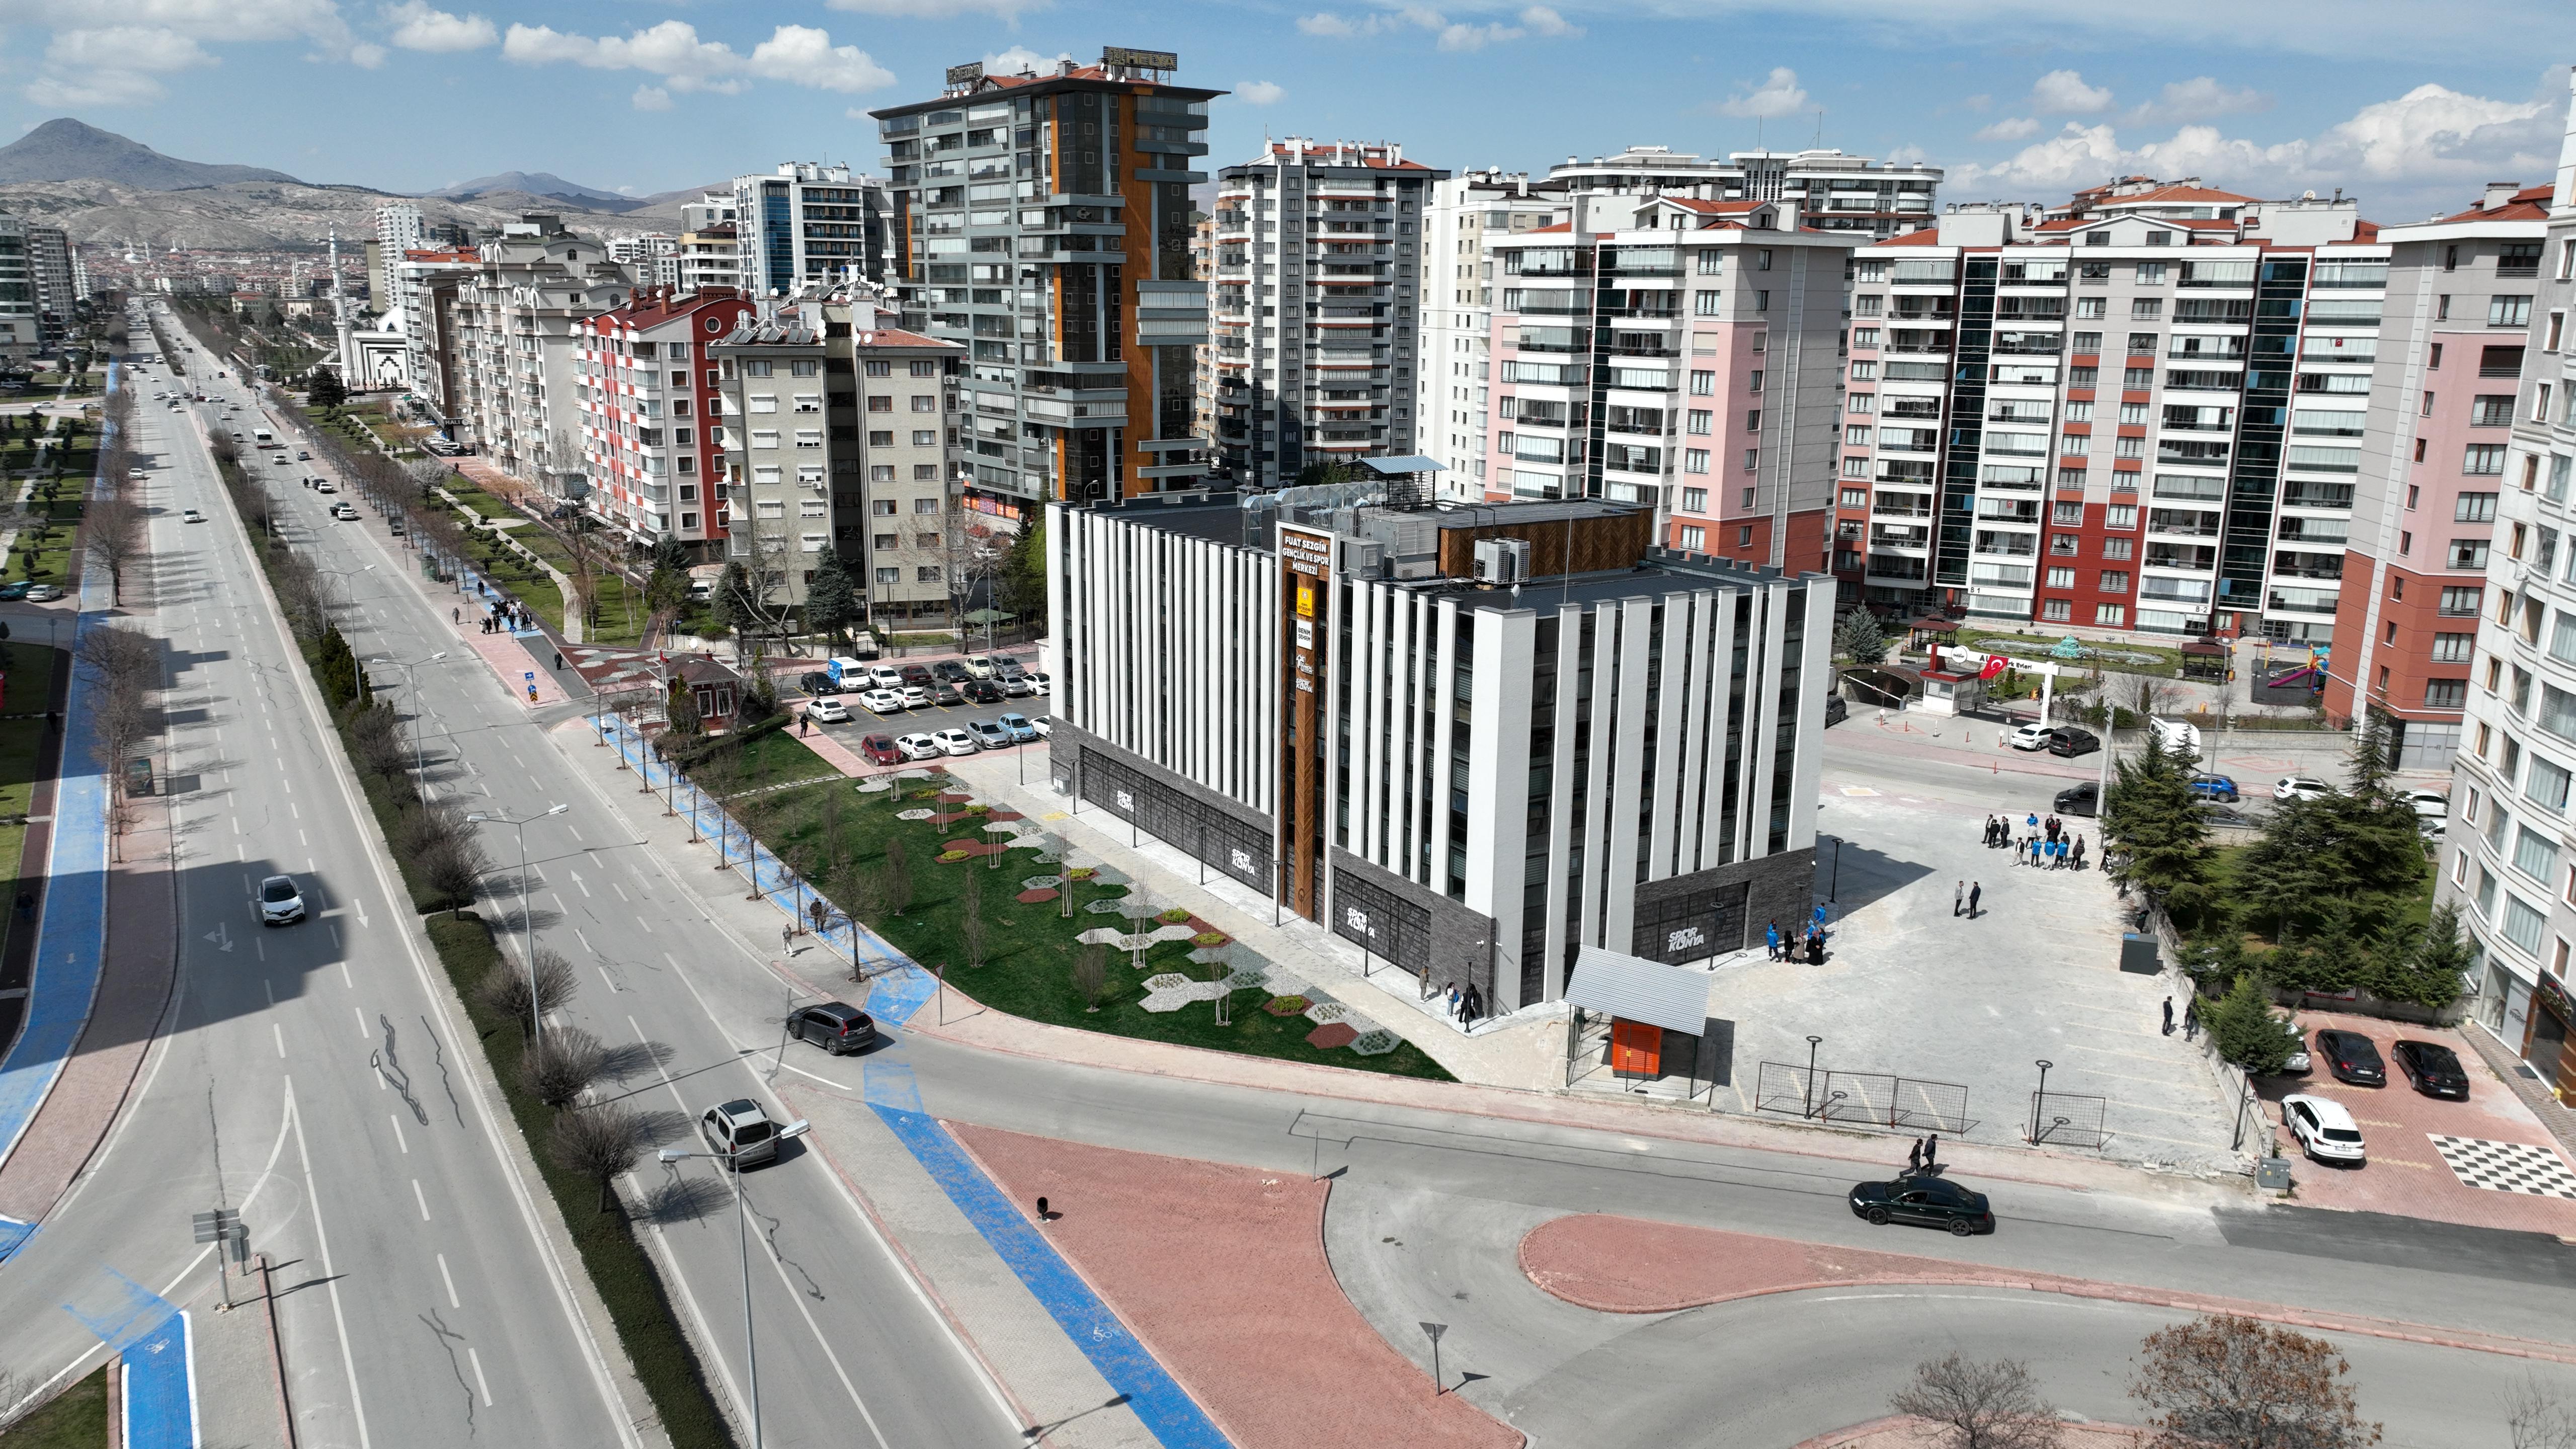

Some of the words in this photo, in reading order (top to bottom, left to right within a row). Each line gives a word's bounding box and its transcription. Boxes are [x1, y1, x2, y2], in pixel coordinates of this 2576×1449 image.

[1126, 51, 1176, 68] HELYA
[954, 65, 982, 81] HELYA
[1285, 536, 1301, 547] FUAT
[1302, 540, 1326, 553] SEZGİN
[1282, 547, 1305, 560] GENÇLİK
[1306, 552, 1313, 562] VE
[1314, 554, 1329, 566] SPOR
[1293, 561, 1317, 576] MERKEZİ
[1296, 678, 1309, 686] SPOR
[1296, 683, 1312, 693] KONYA
[1117, 790, 1132, 803] SPOR
[1232, 848, 1250, 864] SPOR
[1232, 856, 1255, 875] KONYA
[1347, 907, 1369, 925] SPOR
[1347, 916, 1375, 938] KONYA
[1668, 927, 1698, 942] SPOR
[1668, 934, 1704, 952] KONYA
